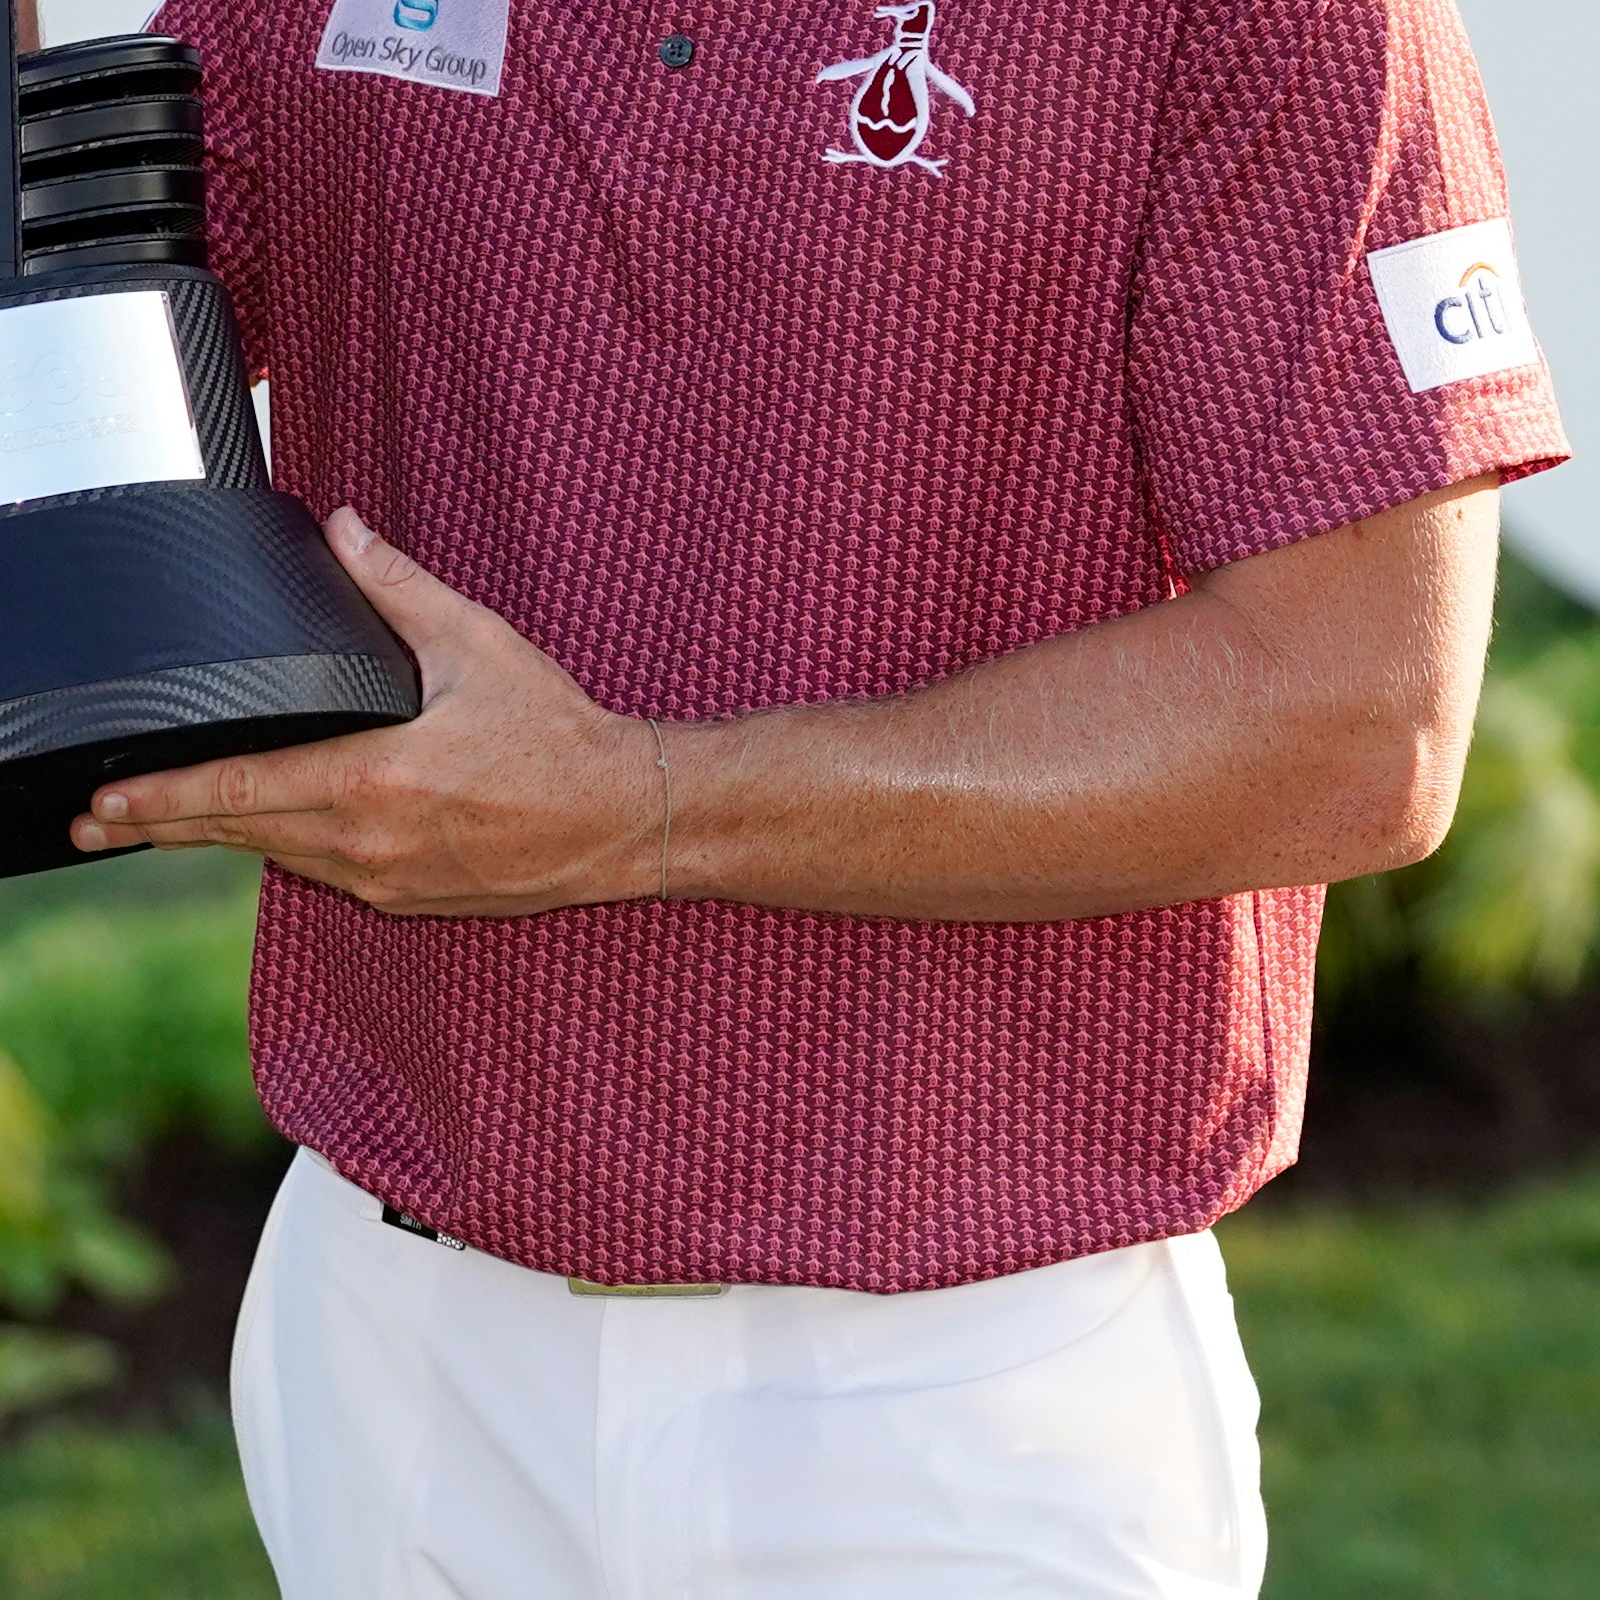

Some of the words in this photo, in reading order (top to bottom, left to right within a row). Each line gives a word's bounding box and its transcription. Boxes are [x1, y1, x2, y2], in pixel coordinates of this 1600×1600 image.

[331, 31, 377, 64] Open
[378, 36, 422, 71] Sky
[424, 45, 488, 84] Group
